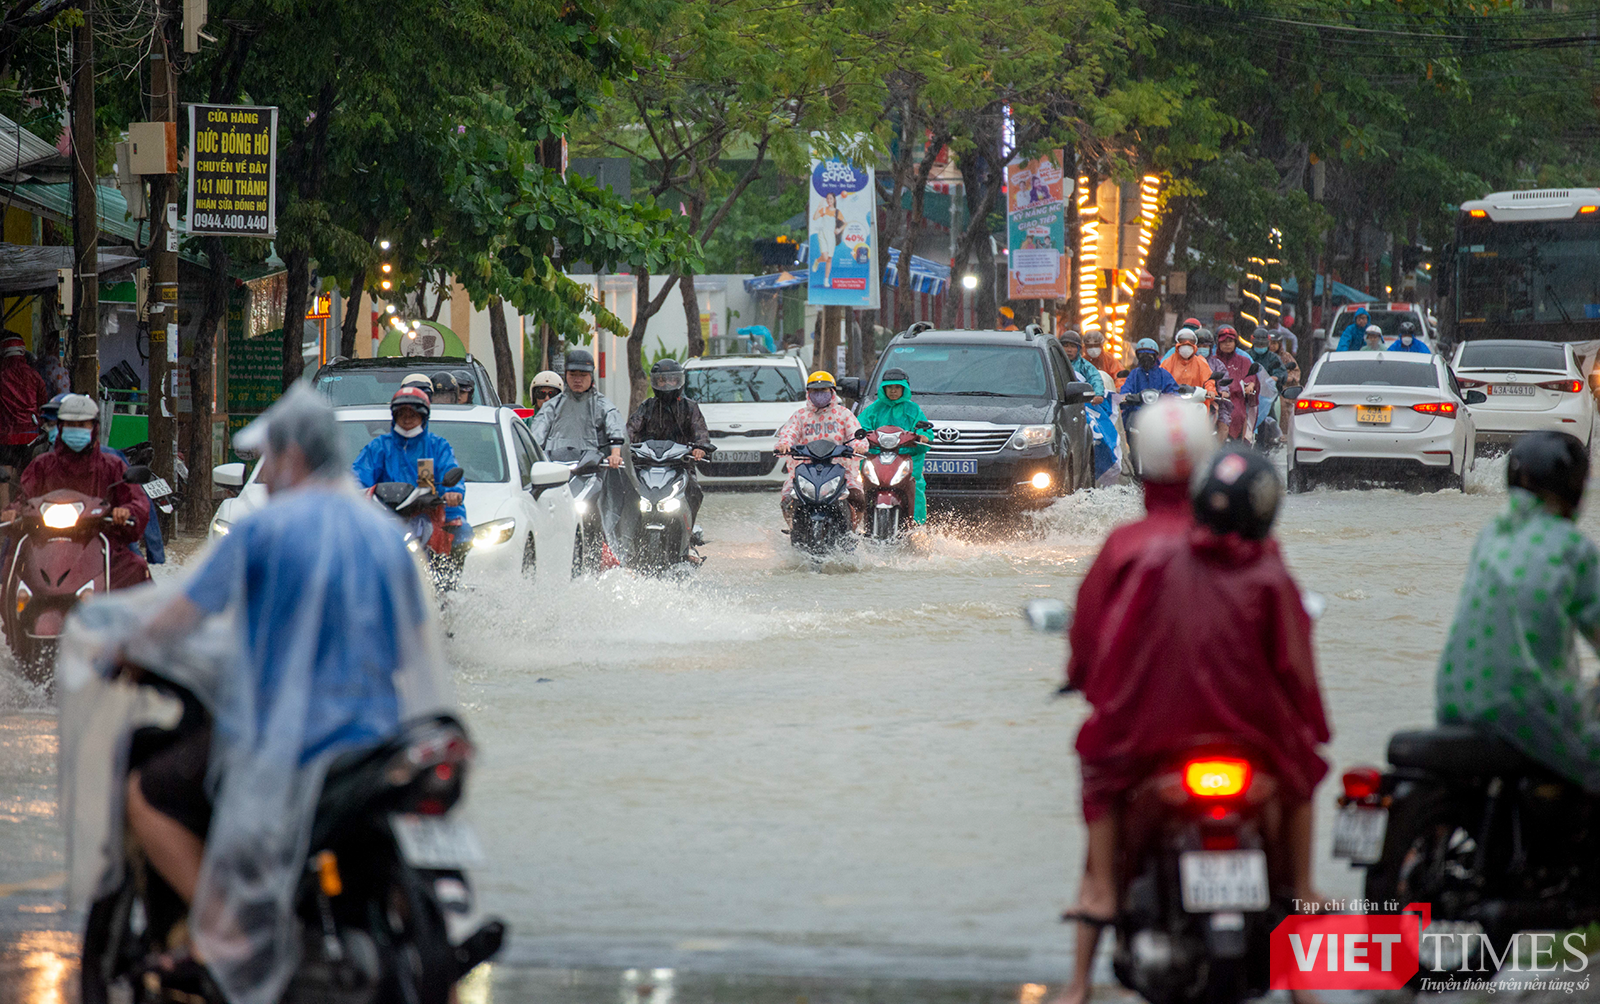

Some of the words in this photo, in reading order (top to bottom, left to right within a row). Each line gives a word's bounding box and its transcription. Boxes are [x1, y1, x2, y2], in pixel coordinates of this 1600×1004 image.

[208, 108, 228, 122] CỬA
[231, 111, 259, 124] HÀNG
[196, 127, 219, 153] ĐỨC
[221, 125, 252, 154] ĐỒNG
[254, 126, 269, 155] HỒ
[197, 157, 233, 173] CHUYỂN
[235, 159, 247, 174] VỀ
[249, 161, 268, 174] ĐÂY
[196, 178, 213, 194] 141
[216, 176, 233, 194] NÚI
[235, 177, 267, 196] THÀNH
[196, 197, 216, 211] NHẬN
[218, 197, 233, 210] SỬA
[234, 198, 255, 211] ĐỒNG
[256, 198, 267, 211] HỒ
[1049, 203, 1062, 212] MC
[194, 213, 268, 230] 0944.400.440
[1018, 219, 1037, 230] GIAO
[845, 234, 865, 242] 40%
[1493, 385, 1534, 395] 43A-449.10
[1361, 414, 1388, 422] 437.51
[923, 461, 975, 473] 3A-001.61
